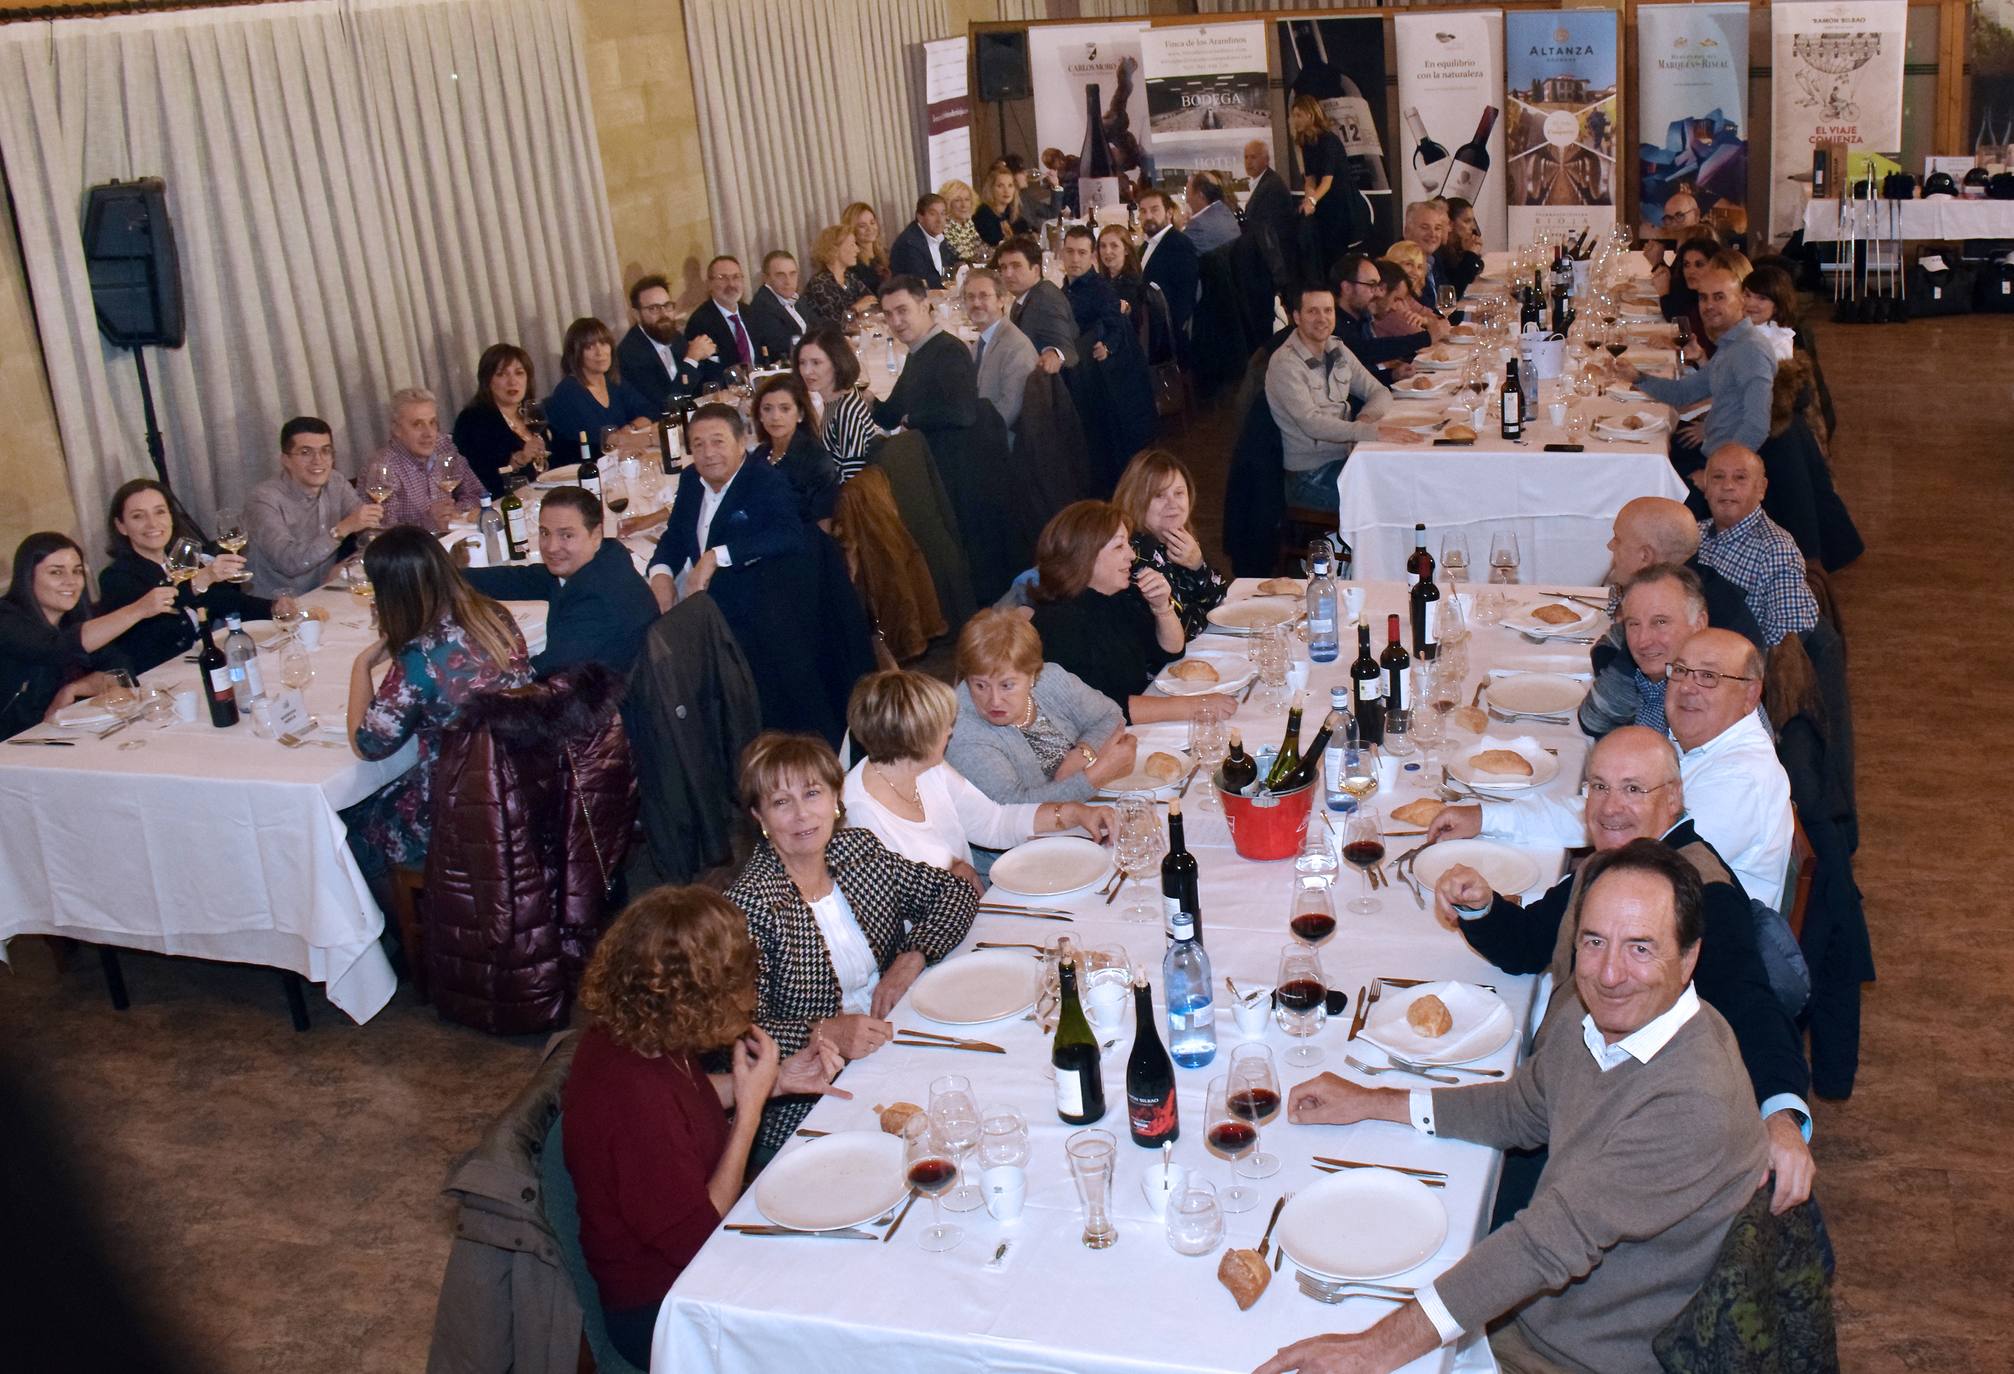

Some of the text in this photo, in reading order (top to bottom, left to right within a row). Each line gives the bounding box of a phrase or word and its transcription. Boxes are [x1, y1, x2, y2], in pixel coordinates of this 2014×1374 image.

[1185, 39, 1195, 48] de
[1196, 38, 1208, 46] los
[1529, 45, 1594, 56] ALTANZA
[1067, 63, 1117, 73] CARLOS MORO
[1424, 58, 1476, 70] En equilibrio
[1416, 69, 1484, 80] con la naturaleza
[1181, 92, 1242, 107] BODEGA
[1338, 123, 1362, 143] 12
[1815, 125, 1857, 135] EL VIAJE
[1808, 135, 1864, 144] COMIENZA
